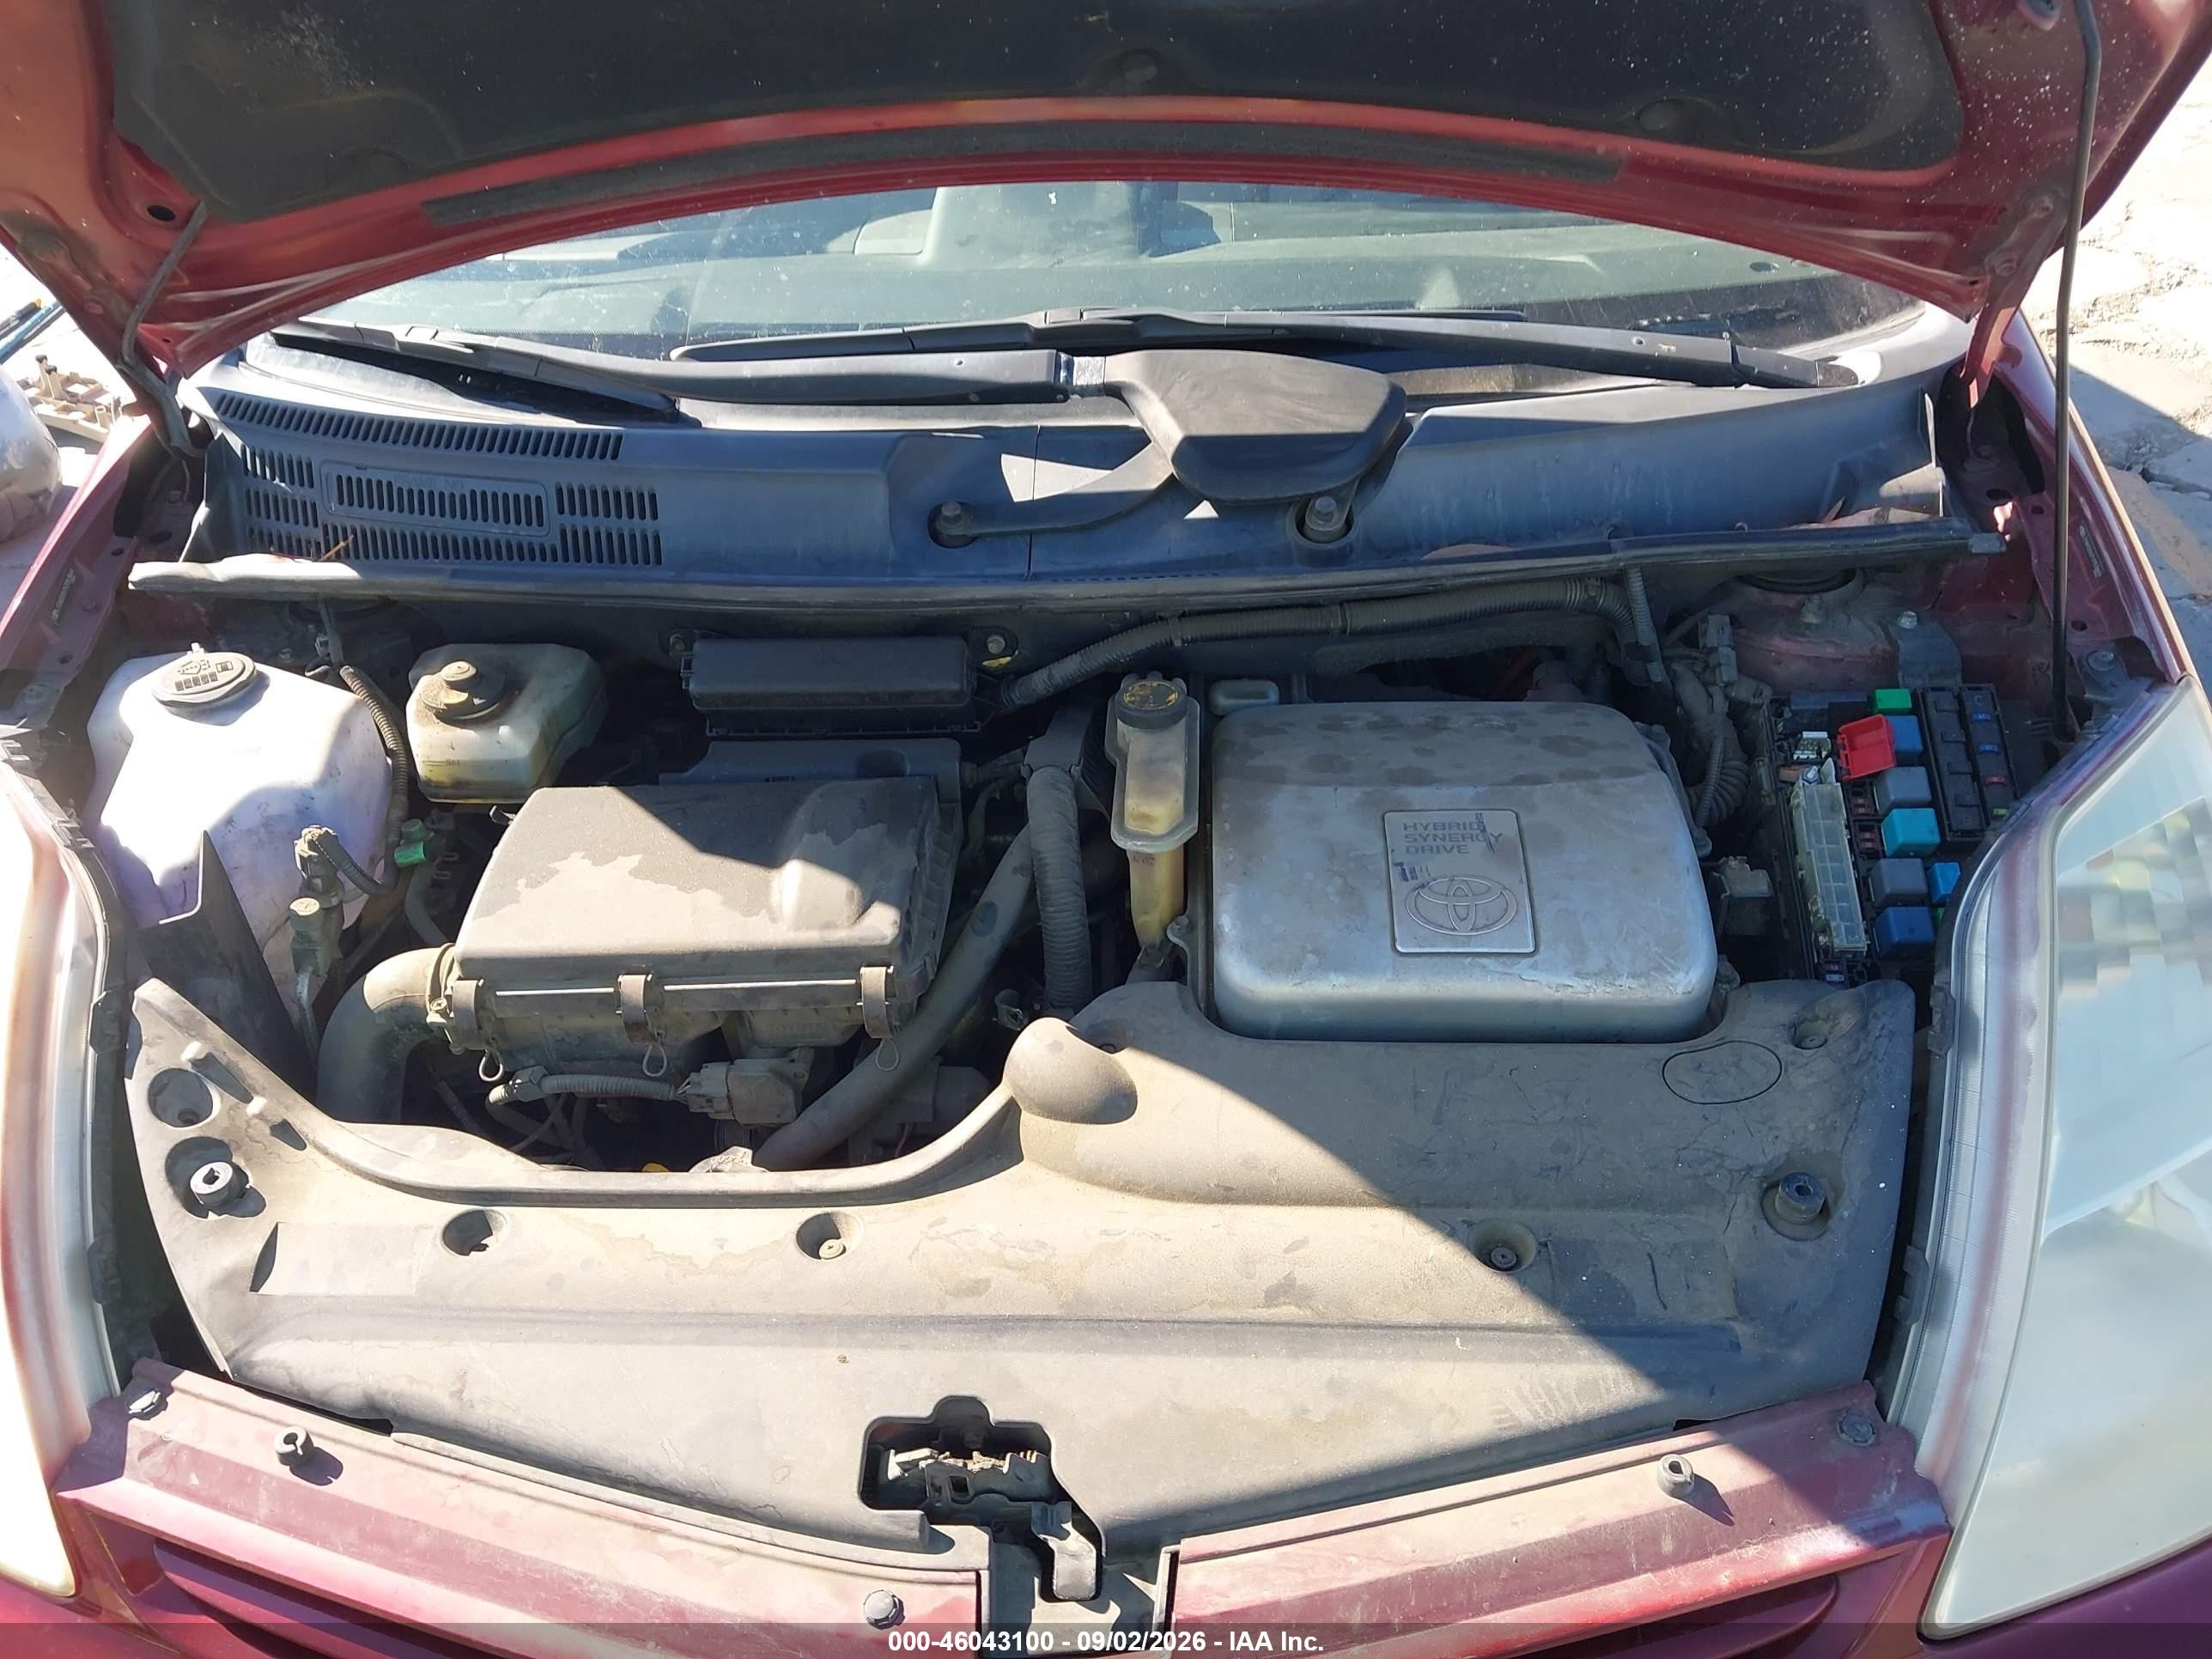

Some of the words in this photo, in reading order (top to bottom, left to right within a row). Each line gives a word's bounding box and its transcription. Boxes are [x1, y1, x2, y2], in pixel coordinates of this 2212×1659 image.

[1403, 822, 1482, 832] HYBRID
[1404, 833, 1503, 842] SYNERGY
[1406, 844, 1470, 854] DRIVE
